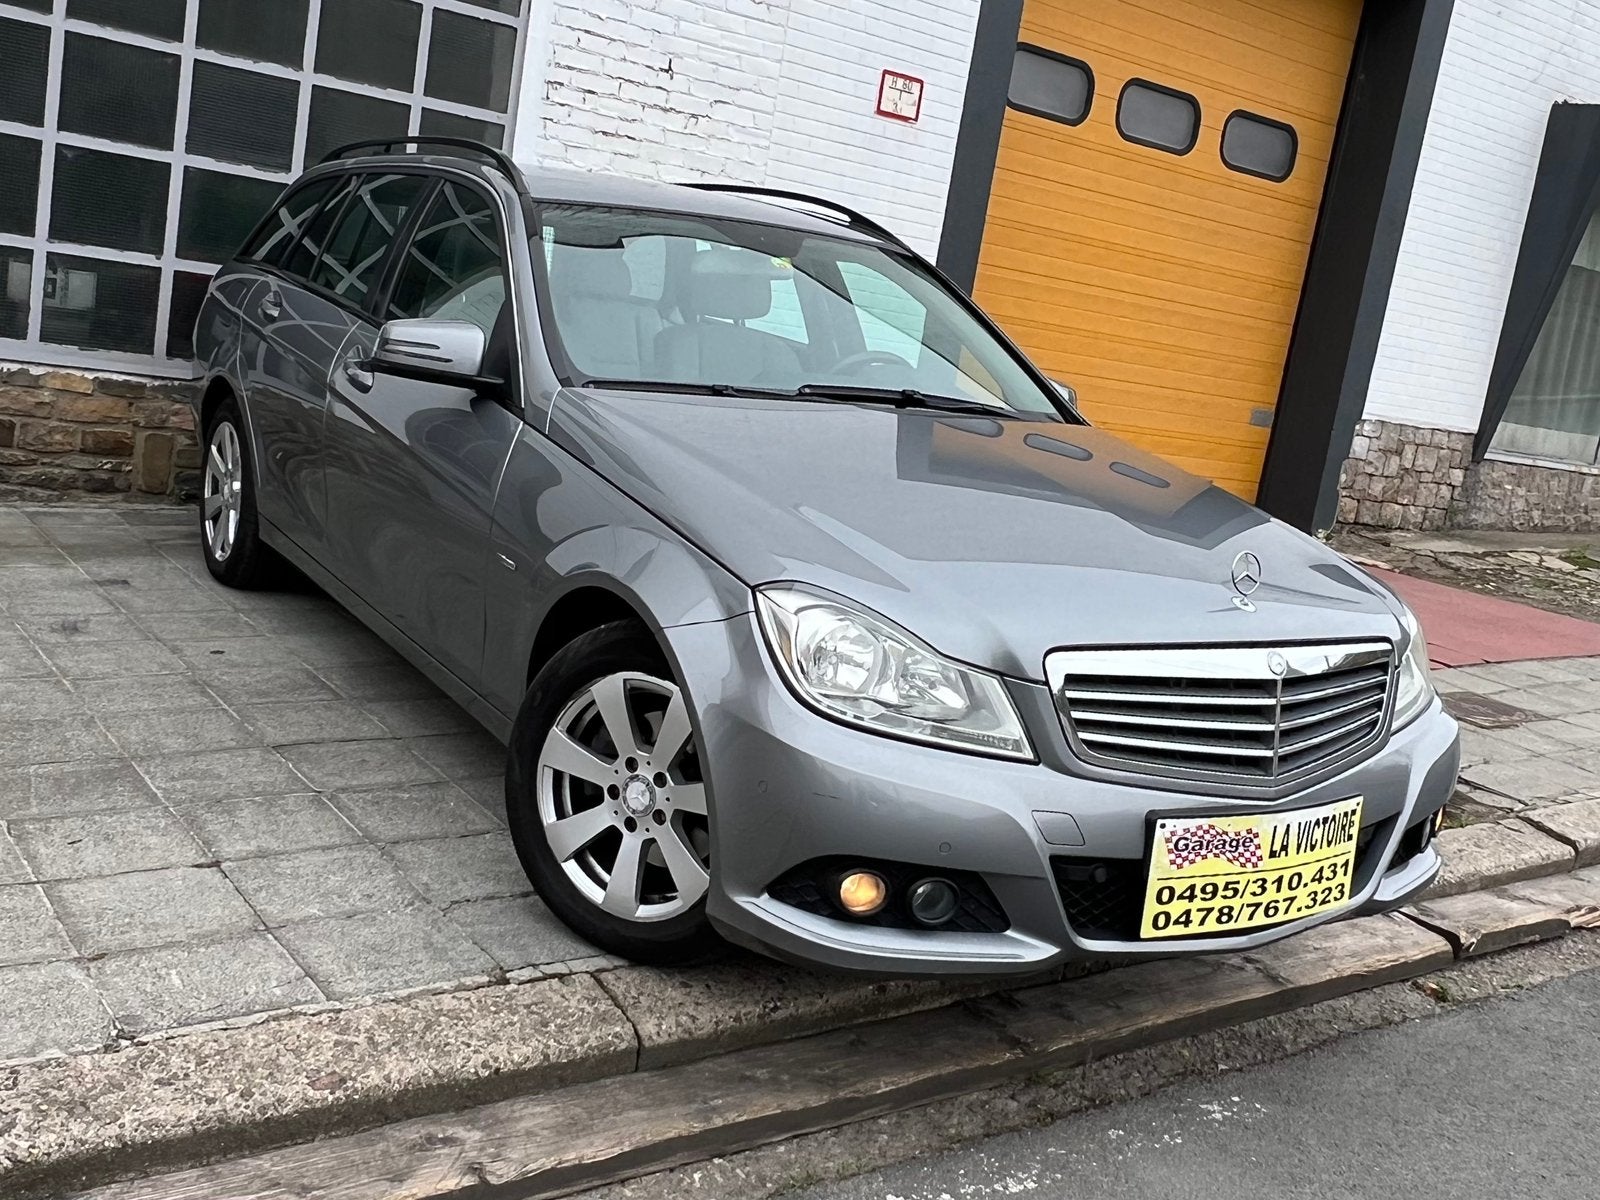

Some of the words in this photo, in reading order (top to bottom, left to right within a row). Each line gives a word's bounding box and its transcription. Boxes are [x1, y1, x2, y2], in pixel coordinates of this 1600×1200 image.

[1173, 834, 1254, 854] Garage
[1268, 824, 1291, 860] LA
[1295, 808, 1357, 855] VICTOIRE
[1151, 882, 1346, 932] 0478/767.323
[1155, 859, 1350, 906] 0495/310.431
